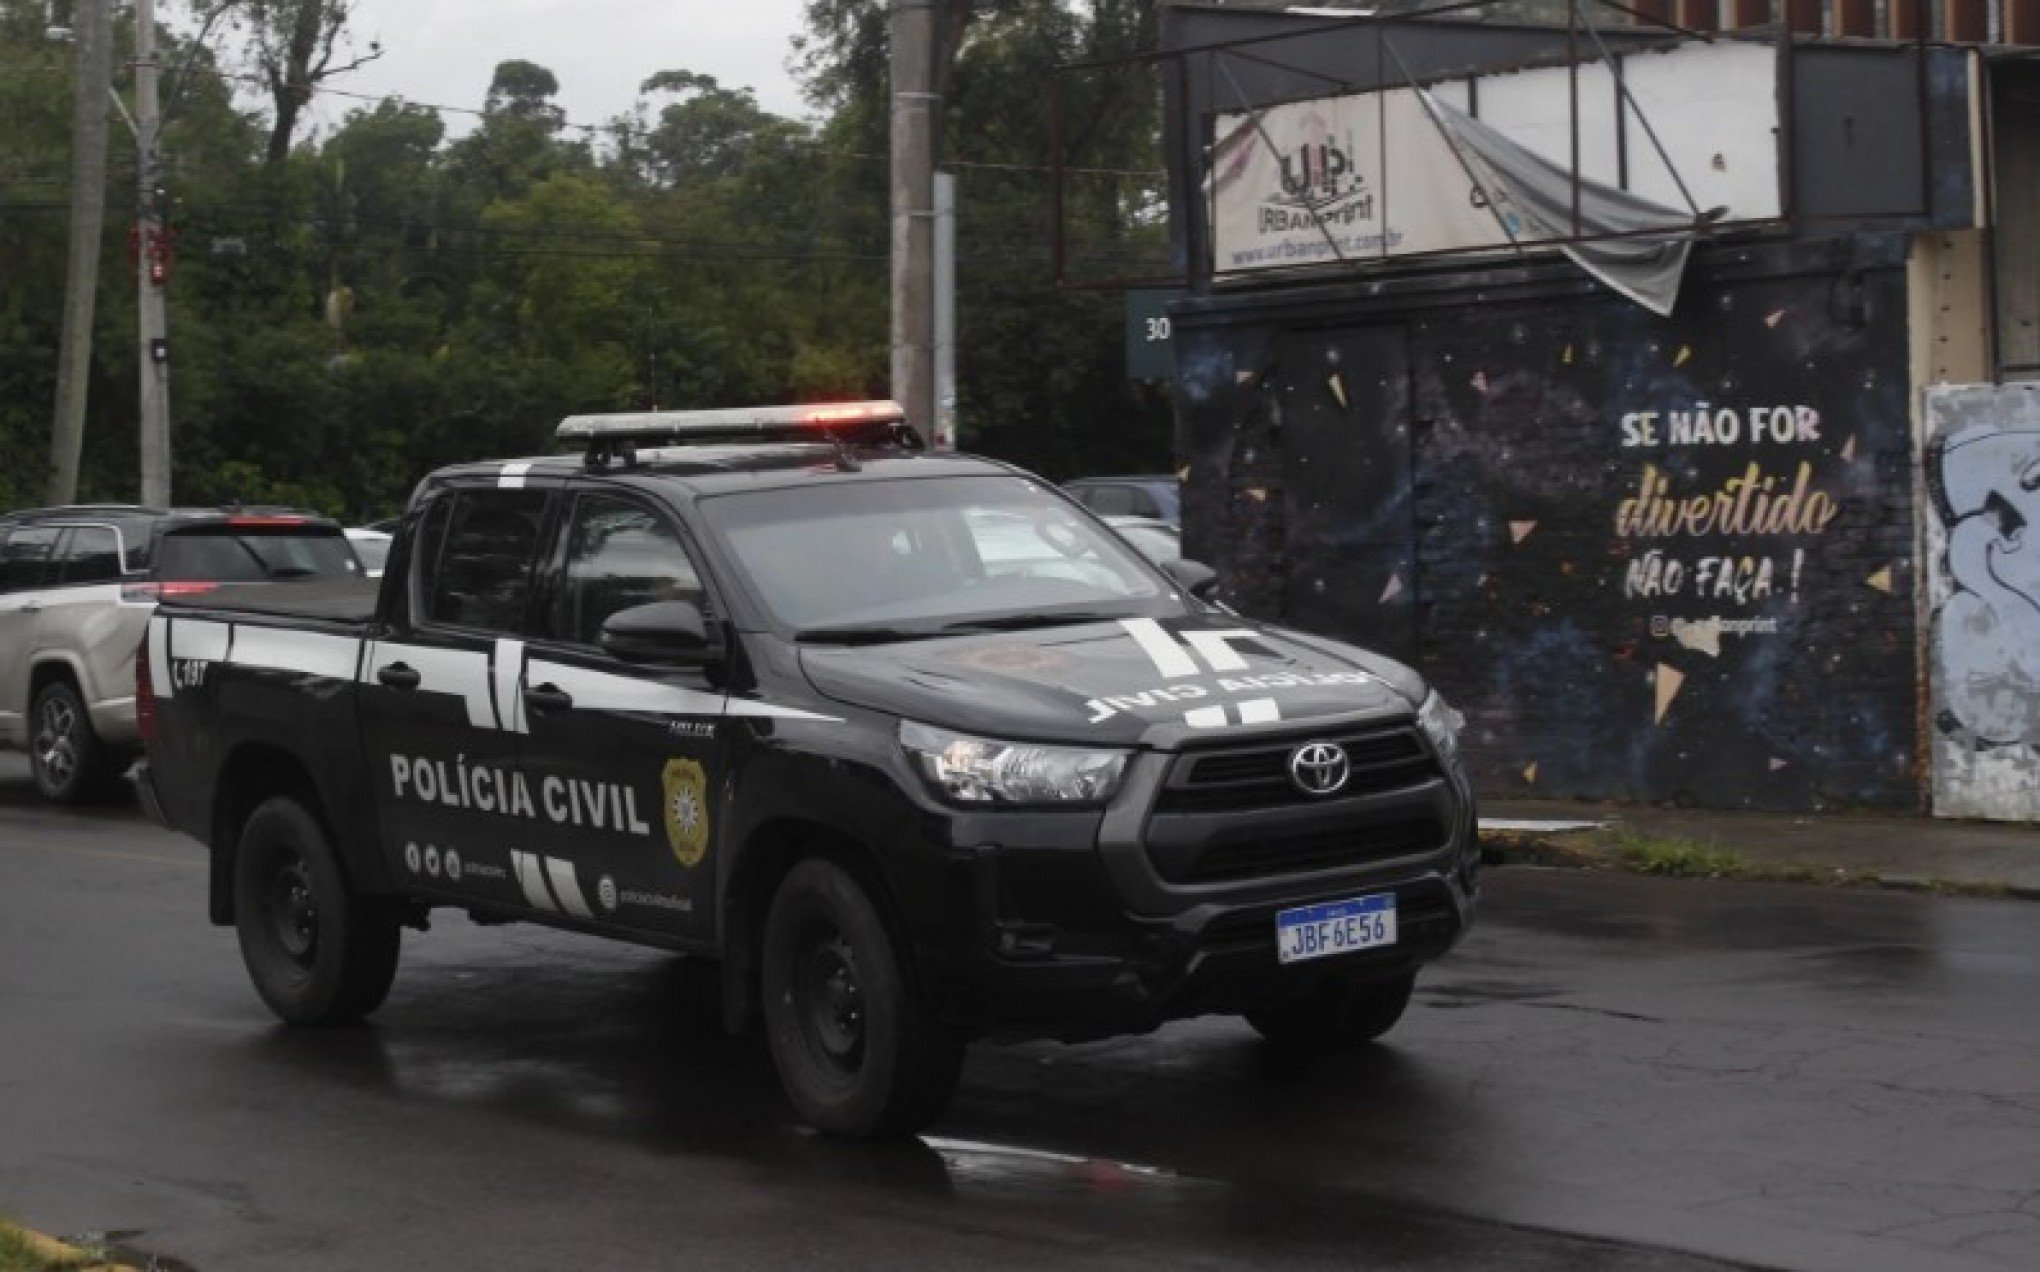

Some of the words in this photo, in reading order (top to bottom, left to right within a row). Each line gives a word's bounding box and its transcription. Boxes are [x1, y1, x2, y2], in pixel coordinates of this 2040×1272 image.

[1620, 411, 1660, 448] SE
[1668, 401, 1741, 445] NÃO
[1748, 404, 1822, 445] FOR
[1615, 459, 1839, 537] divertido
[1624, 548, 1684, 601] NÃO
[1696, 555, 1774, 605] FAÇA
[389, 752, 537, 819] POLÍCIA
[542, 774, 650, 835] CIVIL
[1290, 912, 1385, 956] JBF6E56
